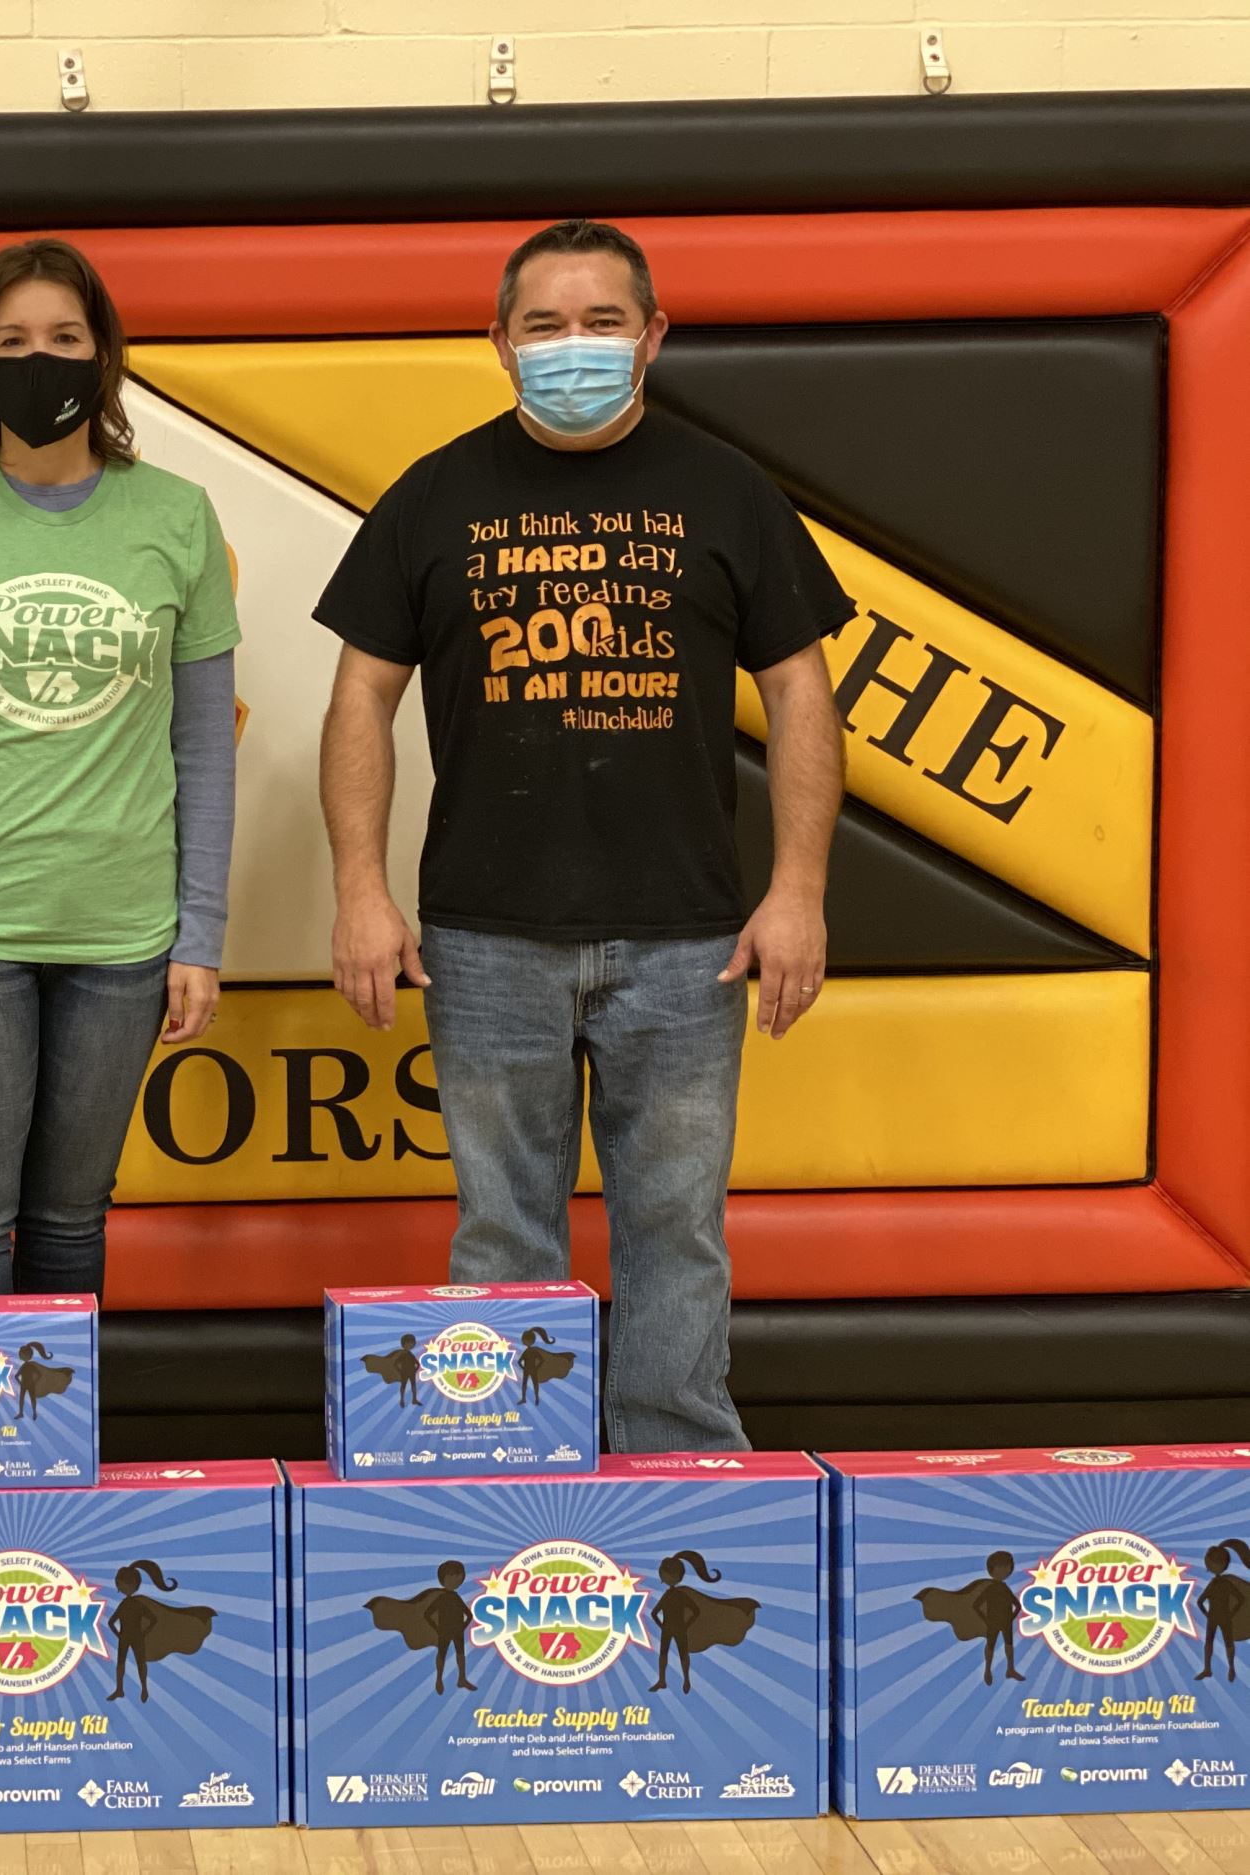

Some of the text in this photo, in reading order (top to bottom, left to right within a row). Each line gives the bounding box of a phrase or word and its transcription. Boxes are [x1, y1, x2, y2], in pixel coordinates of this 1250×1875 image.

[468, 509, 685, 543] you think you had
[466, 540, 683, 580] a HARD day,
[5, 578, 110, 600] IOWA SELECT FARMS
[470, 578, 672, 611] try feeding
[479, 602, 676, 674] 200 kids
[483, 670, 680, 703] IN AN HOUR!
[4, 702, 27, 718] JEFF
[27, 712, 70, 725] HANSEN
[72, 679, 125, 722] FOUNDATION
[562, 705, 673, 730] #lunchdude
[831, 609, 1066, 825] HE
[437, 1338, 499, 1352] Power
[419, 1352, 517, 1380] SNACK
[422, 1412, 520, 1426] Teacher Supply Kit
[1, 1426, 17, 1437] Kit
[507, 1447, 532, 1455] FARM
[507, 1455, 538, 1463] CREDIT
[4, 1469, 37, 1477] CREDIT
[1069, 1536, 1153, 1558] IOWA SELECT FARMS
[521, 1547, 606, 1568] IOWA SELECT FARMS
[0, 1557, 31, 1565] SELECT
[33, 1559, 62, 1578] FARMS
[1052, 1558, 1163, 1584] Power
[504, 1568, 616, 1594] Power
[1021, 1584, 1195, 1636] SNACK
[472, 1594, 649, 1646] SNACK
[1022, 1694, 1196, 1720] Teacher Supply Kit
[474, 1705, 650, 1731] Teacher Supply Kit
[11, 1716, 76, 1741] Supply
[80, 1714, 108, 1734] Kit
[448, 1732, 674, 1746] A program of the Deb and Jeff Hansen Foundation
[513, 1746, 612, 1756] and Iowa Select Farms
[1193, 1759, 1234, 1771] FARM
[648, 1771, 690, 1783] FARM
[740, 1774, 788, 1786] Select
[920, 1775, 976, 1786] HANSEN
[989, 1768, 1042, 1788] Cargill
[1081, 1768, 1147, 1785] provimi
[1191, 1774, 1248, 1787] CREDIT
[107, 1780, 149, 1792] FARM
[199, 1782, 248, 1795] Select
[370, 1784, 428, 1796] HANSEN
[441, 1778, 495, 1798] Cargill
[534, 1779, 602, 1796] provimi
[646, 1786, 703, 1799] CREDIT
[740, 1786, 789, 1794] FARMS
[104, 1795, 163, 1808] CREDIT
[199, 1794, 248, 1803] FARMS
